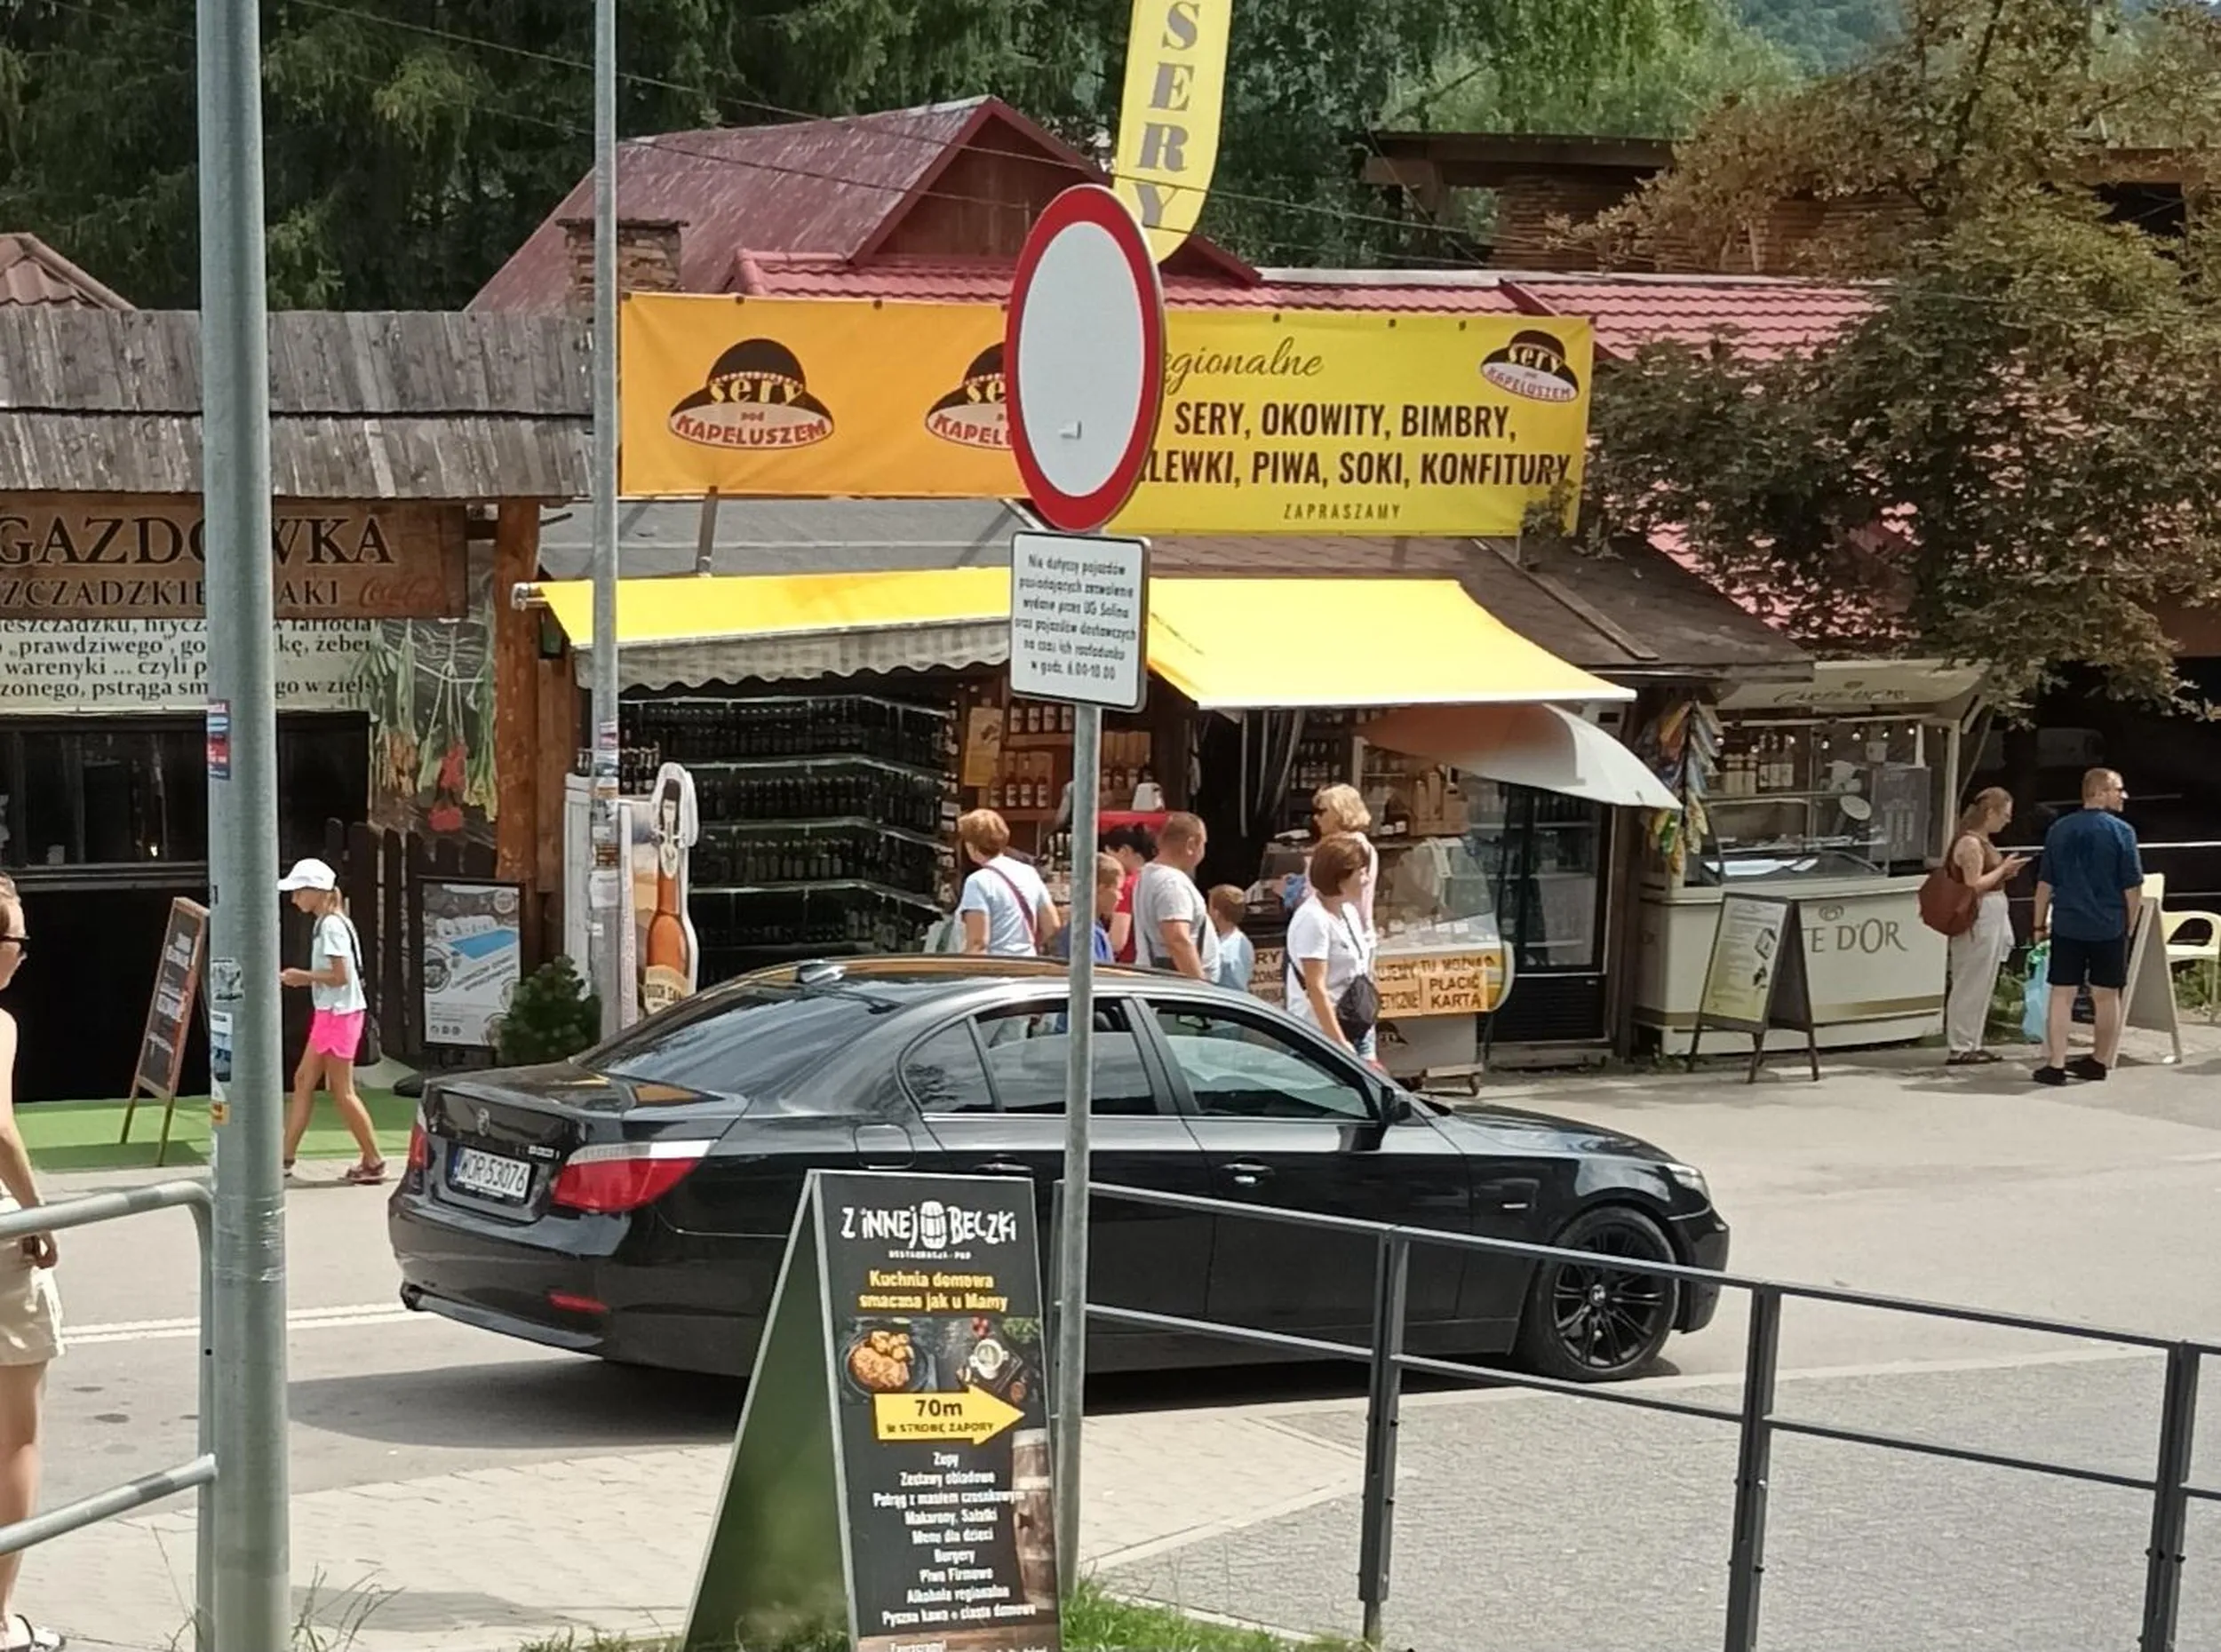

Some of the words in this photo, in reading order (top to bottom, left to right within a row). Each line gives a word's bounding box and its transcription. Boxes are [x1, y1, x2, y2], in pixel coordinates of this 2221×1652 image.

[1134, 1, 1201, 228] SERY
[1165, 336, 1324, 396] gionalne
[967, 380, 1006, 404] se
[676, 415, 827, 445] KAPELUSZEM
[934, 413, 1010, 445] KAPEL
[1174, 401, 1251, 441] SERY,
[1262, 402, 1391, 441] OKOWITY,
[1402, 405, 1516, 443] BIMBRY,
[1139, 449, 1241, 489] LEWKI,
[1252, 451, 1328, 488] PIWA,
[1339, 451, 1410, 488] SOKI,
[1421, 452, 1571, 485] KONFITURY
[1283, 503, 1402, 520] ZAPRASZAMY
[1047, 555, 1079, 575] dotyczy
[279, 579, 338, 607] AKI
[6, 657, 106, 679] warenyki
[139, 656, 187, 679] czyli
[92, 680, 171, 701] pstrąga
[868, 1270, 929, 1288] Kuchnia
[933, 1271, 995, 1289] domowa
[926, 1291, 950, 1312] jak
[952, 1296, 962, 1309] u
[965, 1292, 1008, 1312] Mamy
[914, 1400, 963, 1418] 70m
[933, 1451, 959, 1468] Zupy
[944, 1529, 961, 1543] dla
[934, 1549, 976, 1565] Burgery
